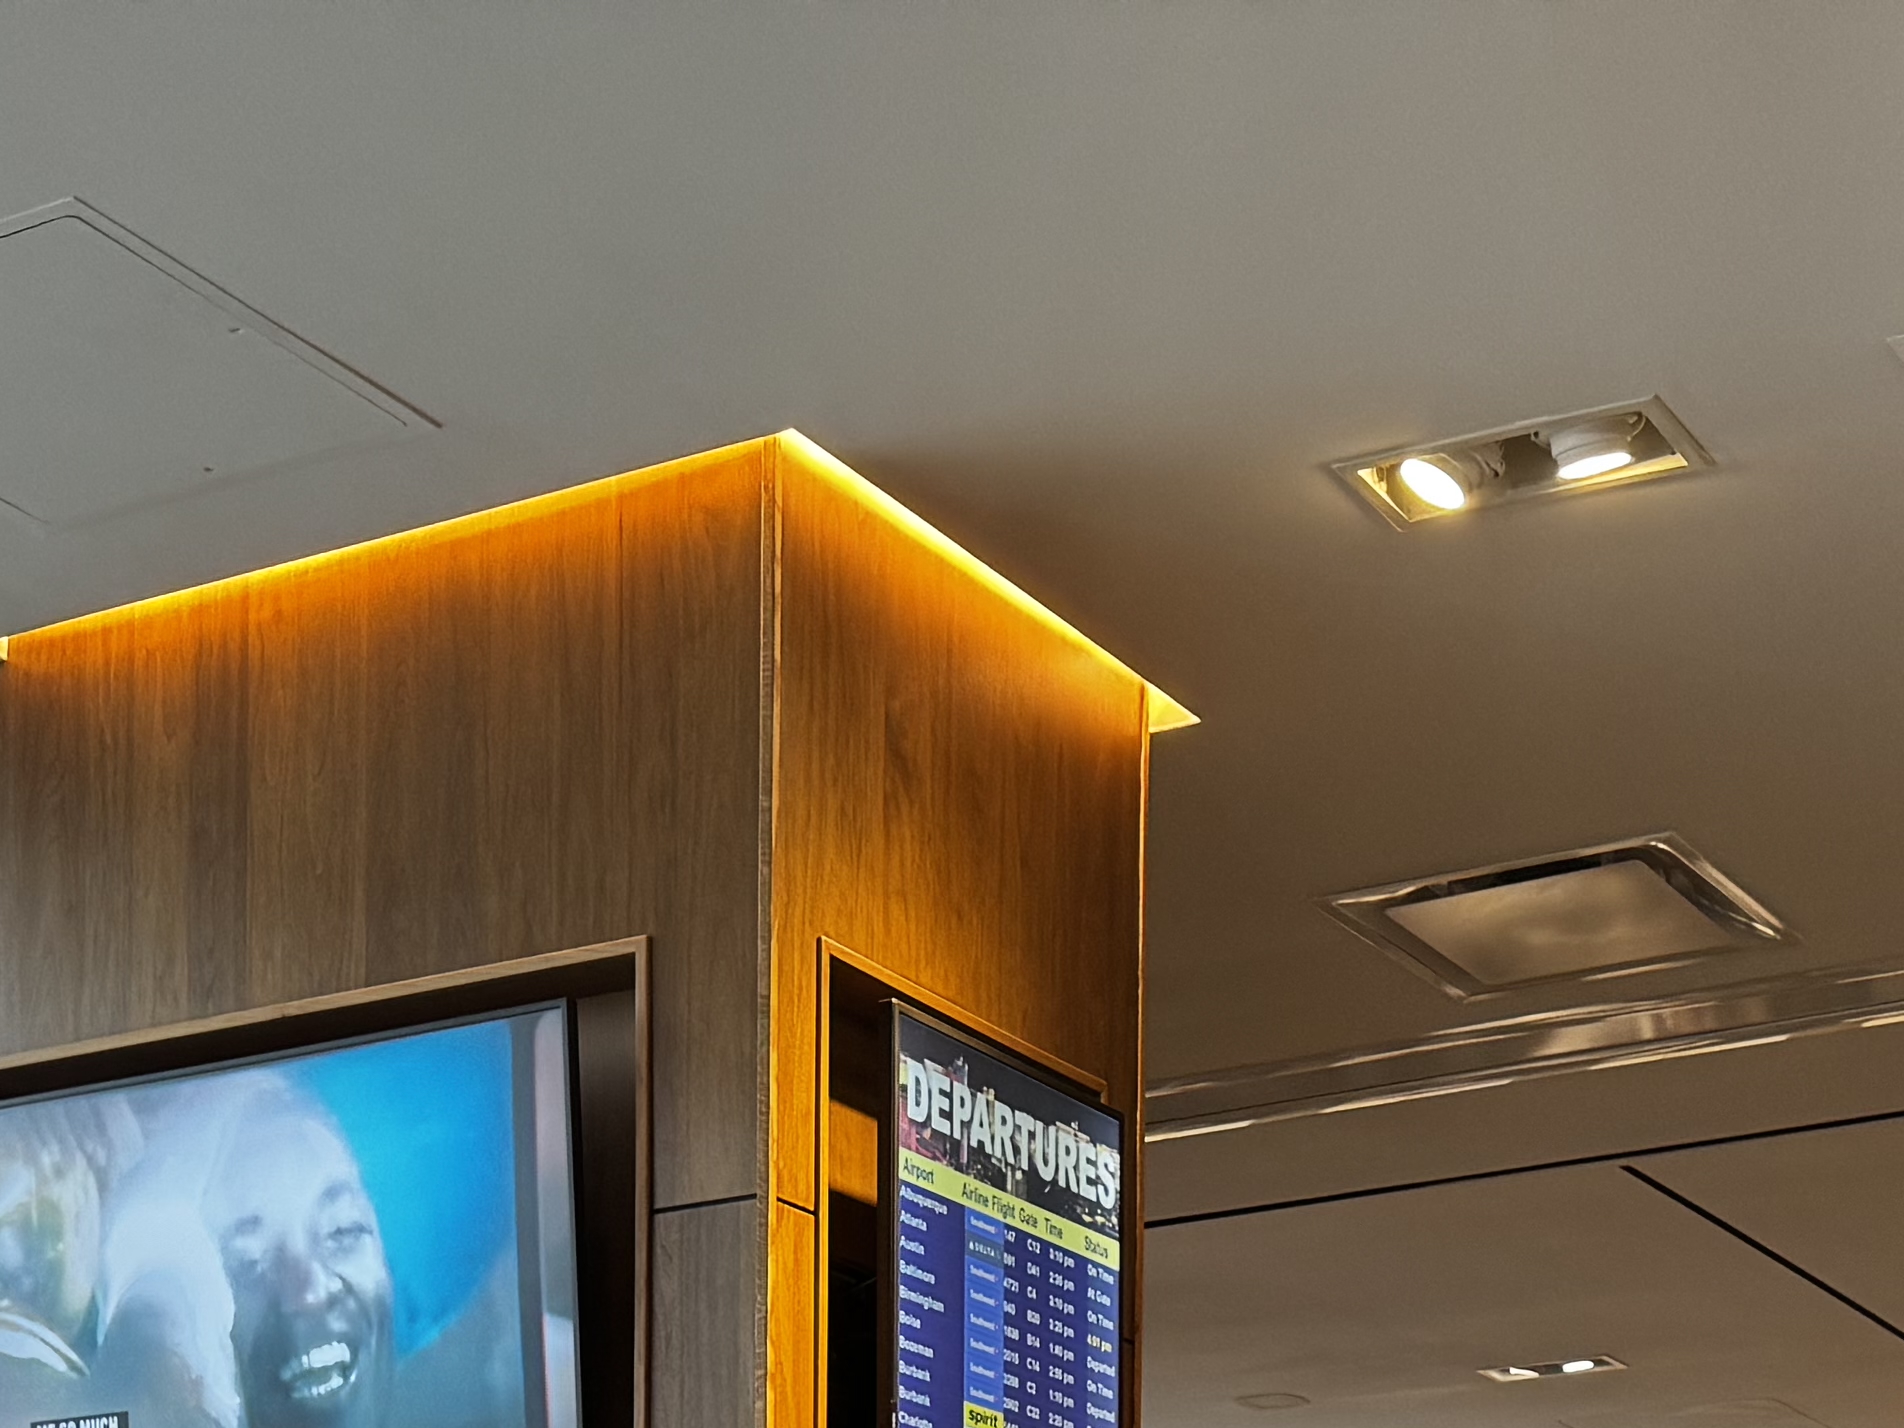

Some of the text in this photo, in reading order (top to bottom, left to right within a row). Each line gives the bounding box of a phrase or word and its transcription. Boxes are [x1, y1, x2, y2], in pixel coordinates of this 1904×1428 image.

[906, 1057, 1117, 1210] DEPARTURES
[902, 1157, 935, 1185] Airport
[961, 1182, 990, 1208] Airline
[992, 1194, 1016, 1220] Flight
[1018, 1208, 1039, 1229] Gate
[1044, 1217, 1064, 1240] Time
[1084, 1235, 1109, 1259] Status
[899, 1235, 924, 1255] Austin
[1087, 1310, 1097, 1324] On
[1097, 1313, 1114, 1330] Time
[1087, 1263, 1097, 1277] On
[1097, 1267, 1114, 1285] Time
[968, 1408, 999, 1428] spirit
[1086, 1379, 1097, 1393] On
[1097, 1382, 1113, 1399] Time
